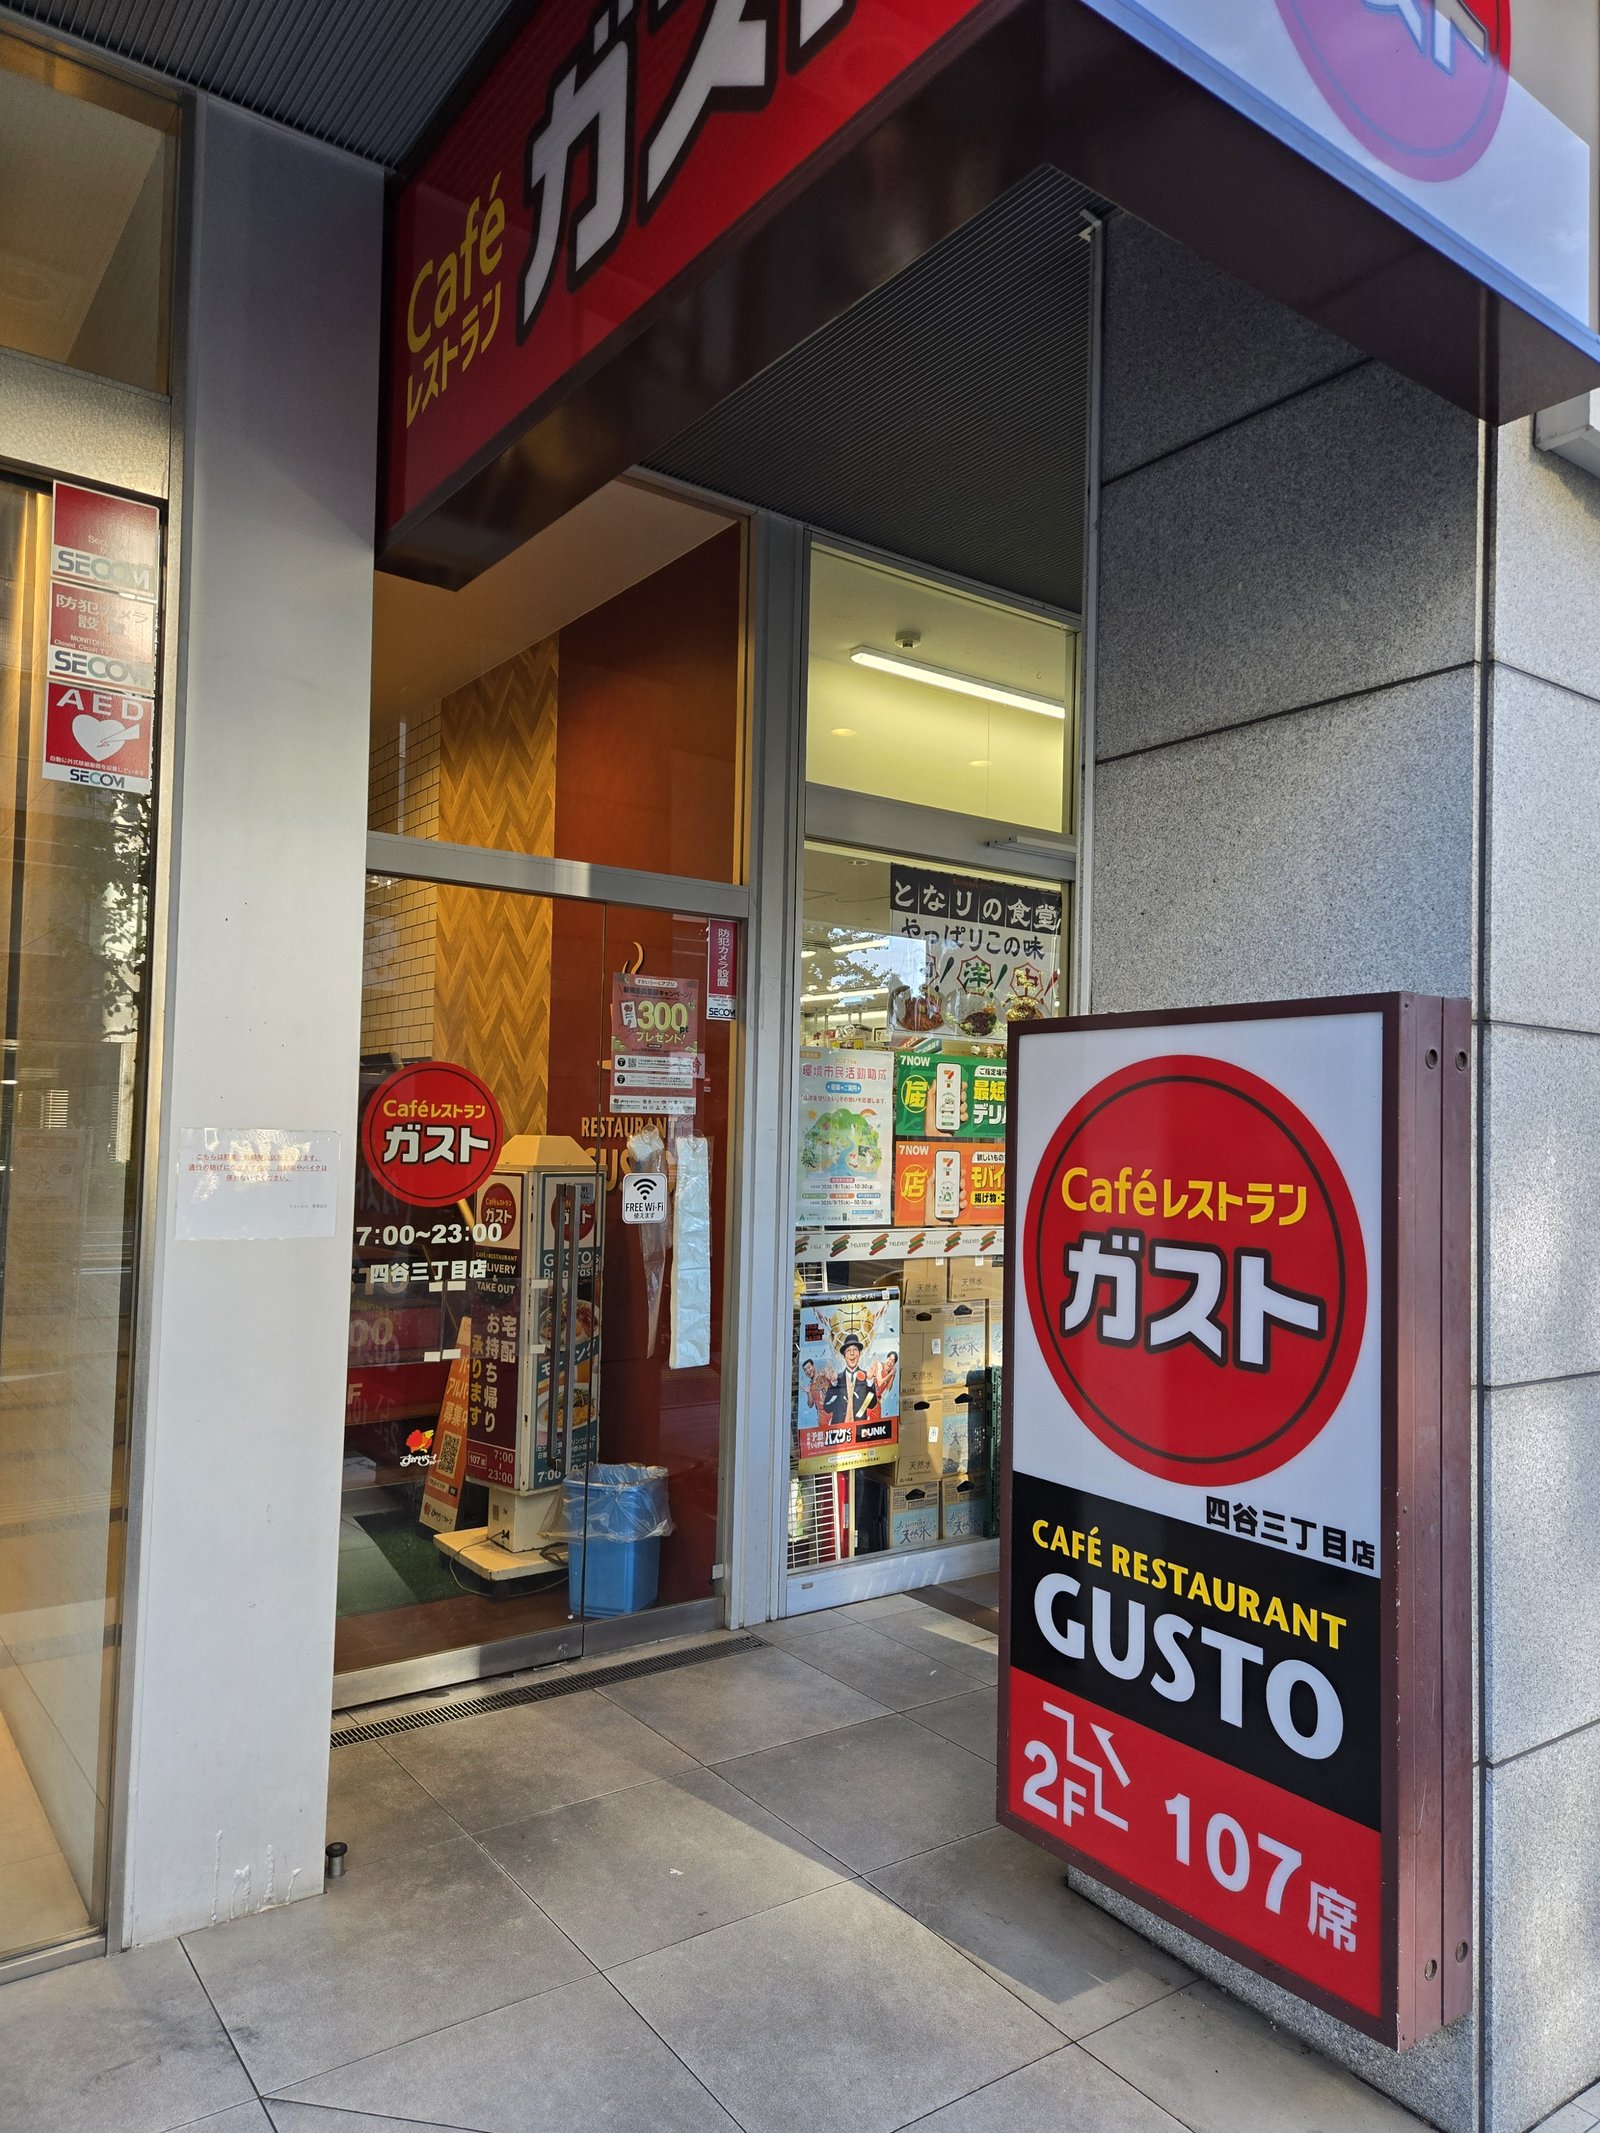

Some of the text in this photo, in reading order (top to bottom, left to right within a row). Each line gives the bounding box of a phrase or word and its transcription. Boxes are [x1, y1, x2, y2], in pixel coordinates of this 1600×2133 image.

[407, 170, 505, 353] Café
[406, 280, 501, 429] レストラン
[58, 550, 149, 590] SECOM
[55, 650, 147, 686] SECOM
[56, 689, 144, 721] AED
[70, 769, 125, 788] SECOM
[895, 879, 1058, 931] となりの食堂
[902, 917, 1045, 960] やっぱりこの味
[717, 928, 730, 988] 防犯カメラ設置
[637, 1001, 688, 1031] 300
[679, 1025, 689, 1034] pt
[709, 1007, 736, 1017] SECOM
[636, 1031, 686, 1044] プレゼント!
[802, 1064, 887, 1080] 環境市民活動助成
[900, 1055, 930, 1066] 7NOW
[383, 1124, 489, 1164] ガスト
[899, 1145, 929, 1155] 7NOW
[977, 1154, 1005, 1162] 欲しいもの
[901, 1168, 928, 1198] 店
[485, 1209, 512, 1224] ガスト
[626, 1202, 664, 1212] FREE Wi-Fi
[370, 1260, 487, 1284] 四谷三丁目店
[917, 1283, 938, 1292] 天然水
[962, 1278, 982, 1288] 天然水
[477, 1281, 515, 1295] TAKE OUT
[1062, 1231, 1322, 1368] ガスト
[500, 1315, 517, 1364] 宅配
[470, 1334, 484, 1426] 承ります
[483, 1313, 500, 1433] お持ち帰り
[861, 1426, 886, 1438] DUNK
[494, 1450, 513, 1464] 7:00
[909, 1461, 932, 1471] 天然水
[488, 1468, 513, 1484] 23:00
[1206, 1496, 1376, 1570] 四谷三丁目店
[1032, 1519, 1347, 1650] CAFÉ RESTAURANT
[1034, 1572, 1344, 1760] GUSTO
[1022, 1740, 1086, 1827] 2F
